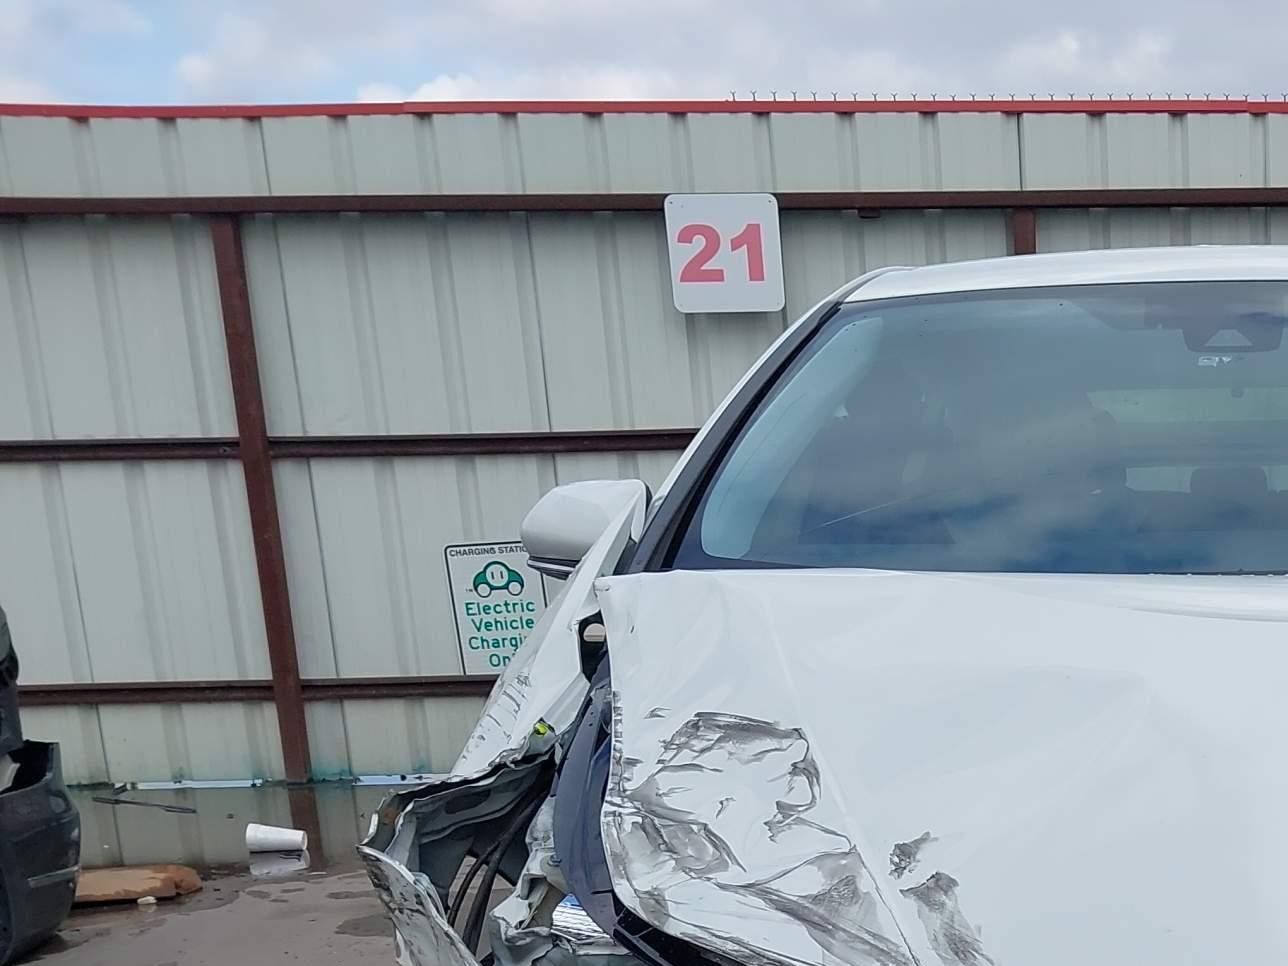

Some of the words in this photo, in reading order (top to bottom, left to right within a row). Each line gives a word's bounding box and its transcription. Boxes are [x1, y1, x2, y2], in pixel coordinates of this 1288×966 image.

[677, 223, 765, 283] 21
[449, 547, 497, 557] CHARGING
[464, 600, 536, 616] Electric
[471, 617, 535, 633] Vehicle
[468, 633, 527, 652] Chargi
[489, 652, 516, 668] On
